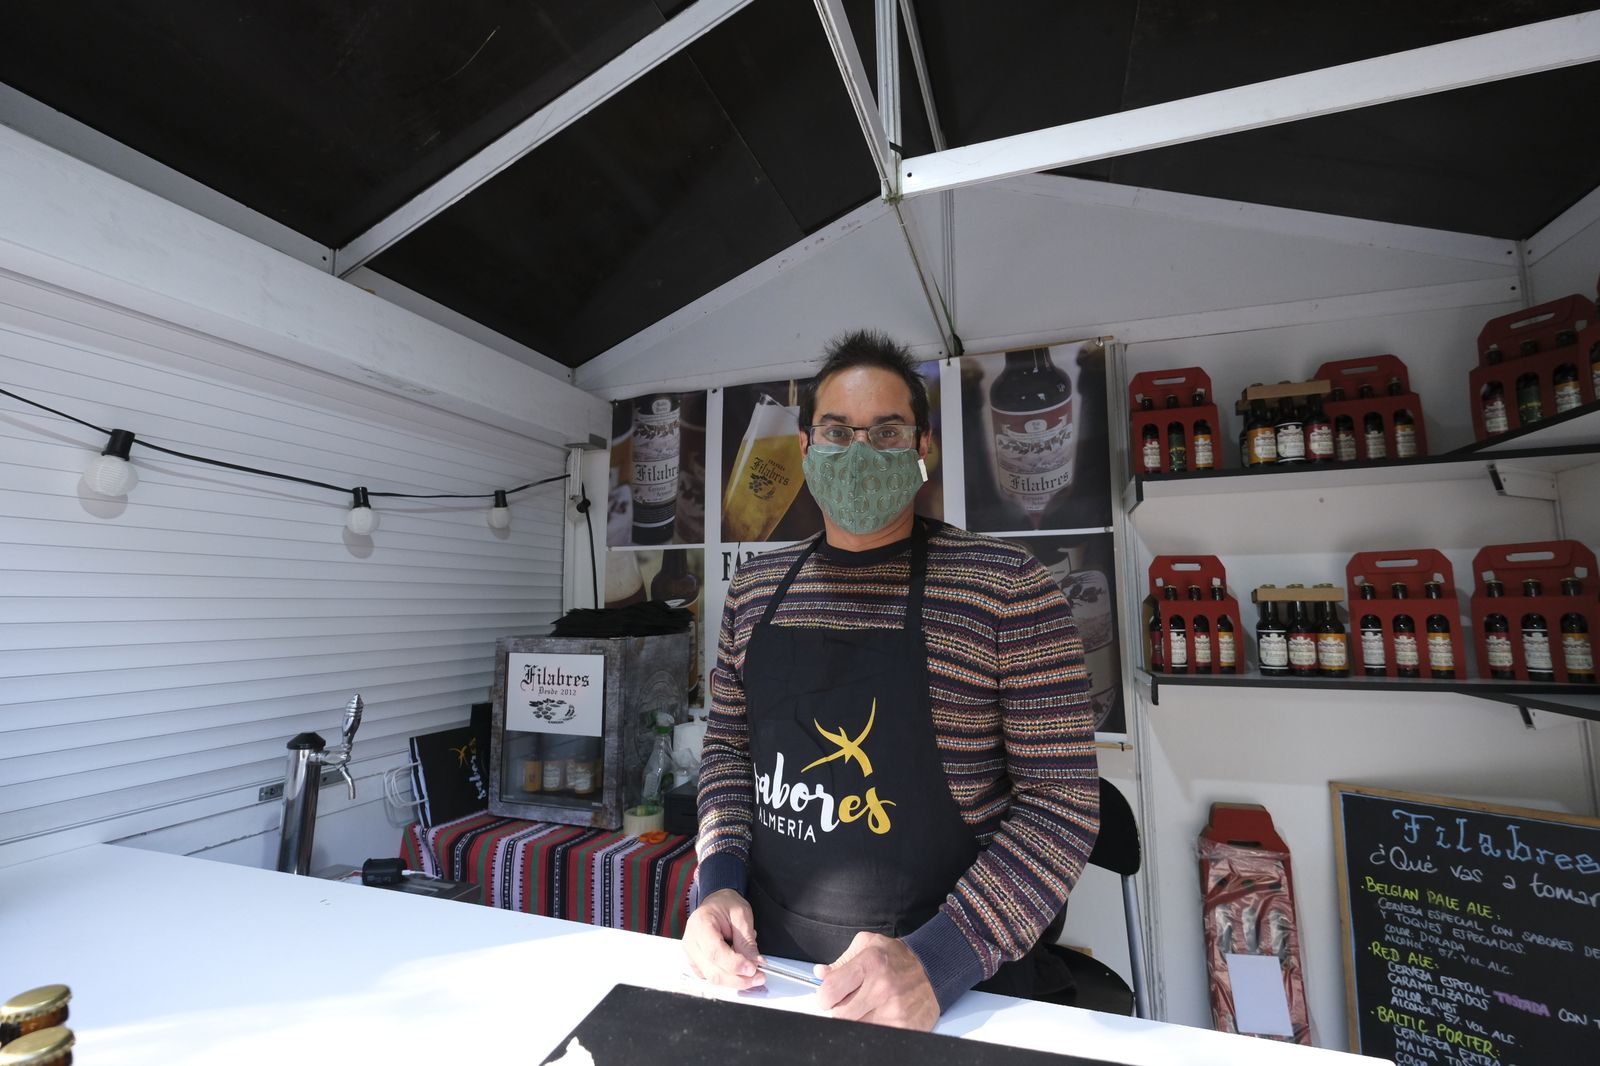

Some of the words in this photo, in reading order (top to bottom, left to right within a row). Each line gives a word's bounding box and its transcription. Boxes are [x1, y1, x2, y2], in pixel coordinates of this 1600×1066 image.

[1009, 471, 1069, 491] Filabres
[520, 664, 590, 691] Filabres
[538, 686, 558, 697] Desde
[560, 687, 577, 697] 2012
[753, 752, 897, 835] abores
[1392, 809, 1600, 875] Filabres
[1369, 843, 1438, 874] ¿Qué
[1450, 865, 1484, 883] vas
[1502, 875, 1516, 889] a
[1529, 873, 1600, 907] tomar
[1364, 876, 1419, 901] BELGIAN
[1427, 889, 1460, 911] PALE
[1378, 897, 1423, 916] CERVEZA
[1428, 910, 1483, 931] ESPECIAL
[1491, 925, 1513, 937] CON
[1522, 931, 1574, 952] SABORES
[1380, 909, 1387, 920] Y
[1395, 913, 1442, 933] TOQUES
[1372, 941, 1400, 962] RED
[1420, 932, 1465, 952] DORADA
[1387, 973, 1489, 1011] CARAMELIZADOS
[1440, 975, 1491, 998] ESPECIAL
[1558, 1008, 1587, 1025] CON
[1377, 1006, 1428, 1033] BALTIC
[1466, 1020, 1488, 1035] VOL
[1393, 1024, 1453, 1054] CERVEZA
[1396, 1038, 1438, 1061] MALTA
